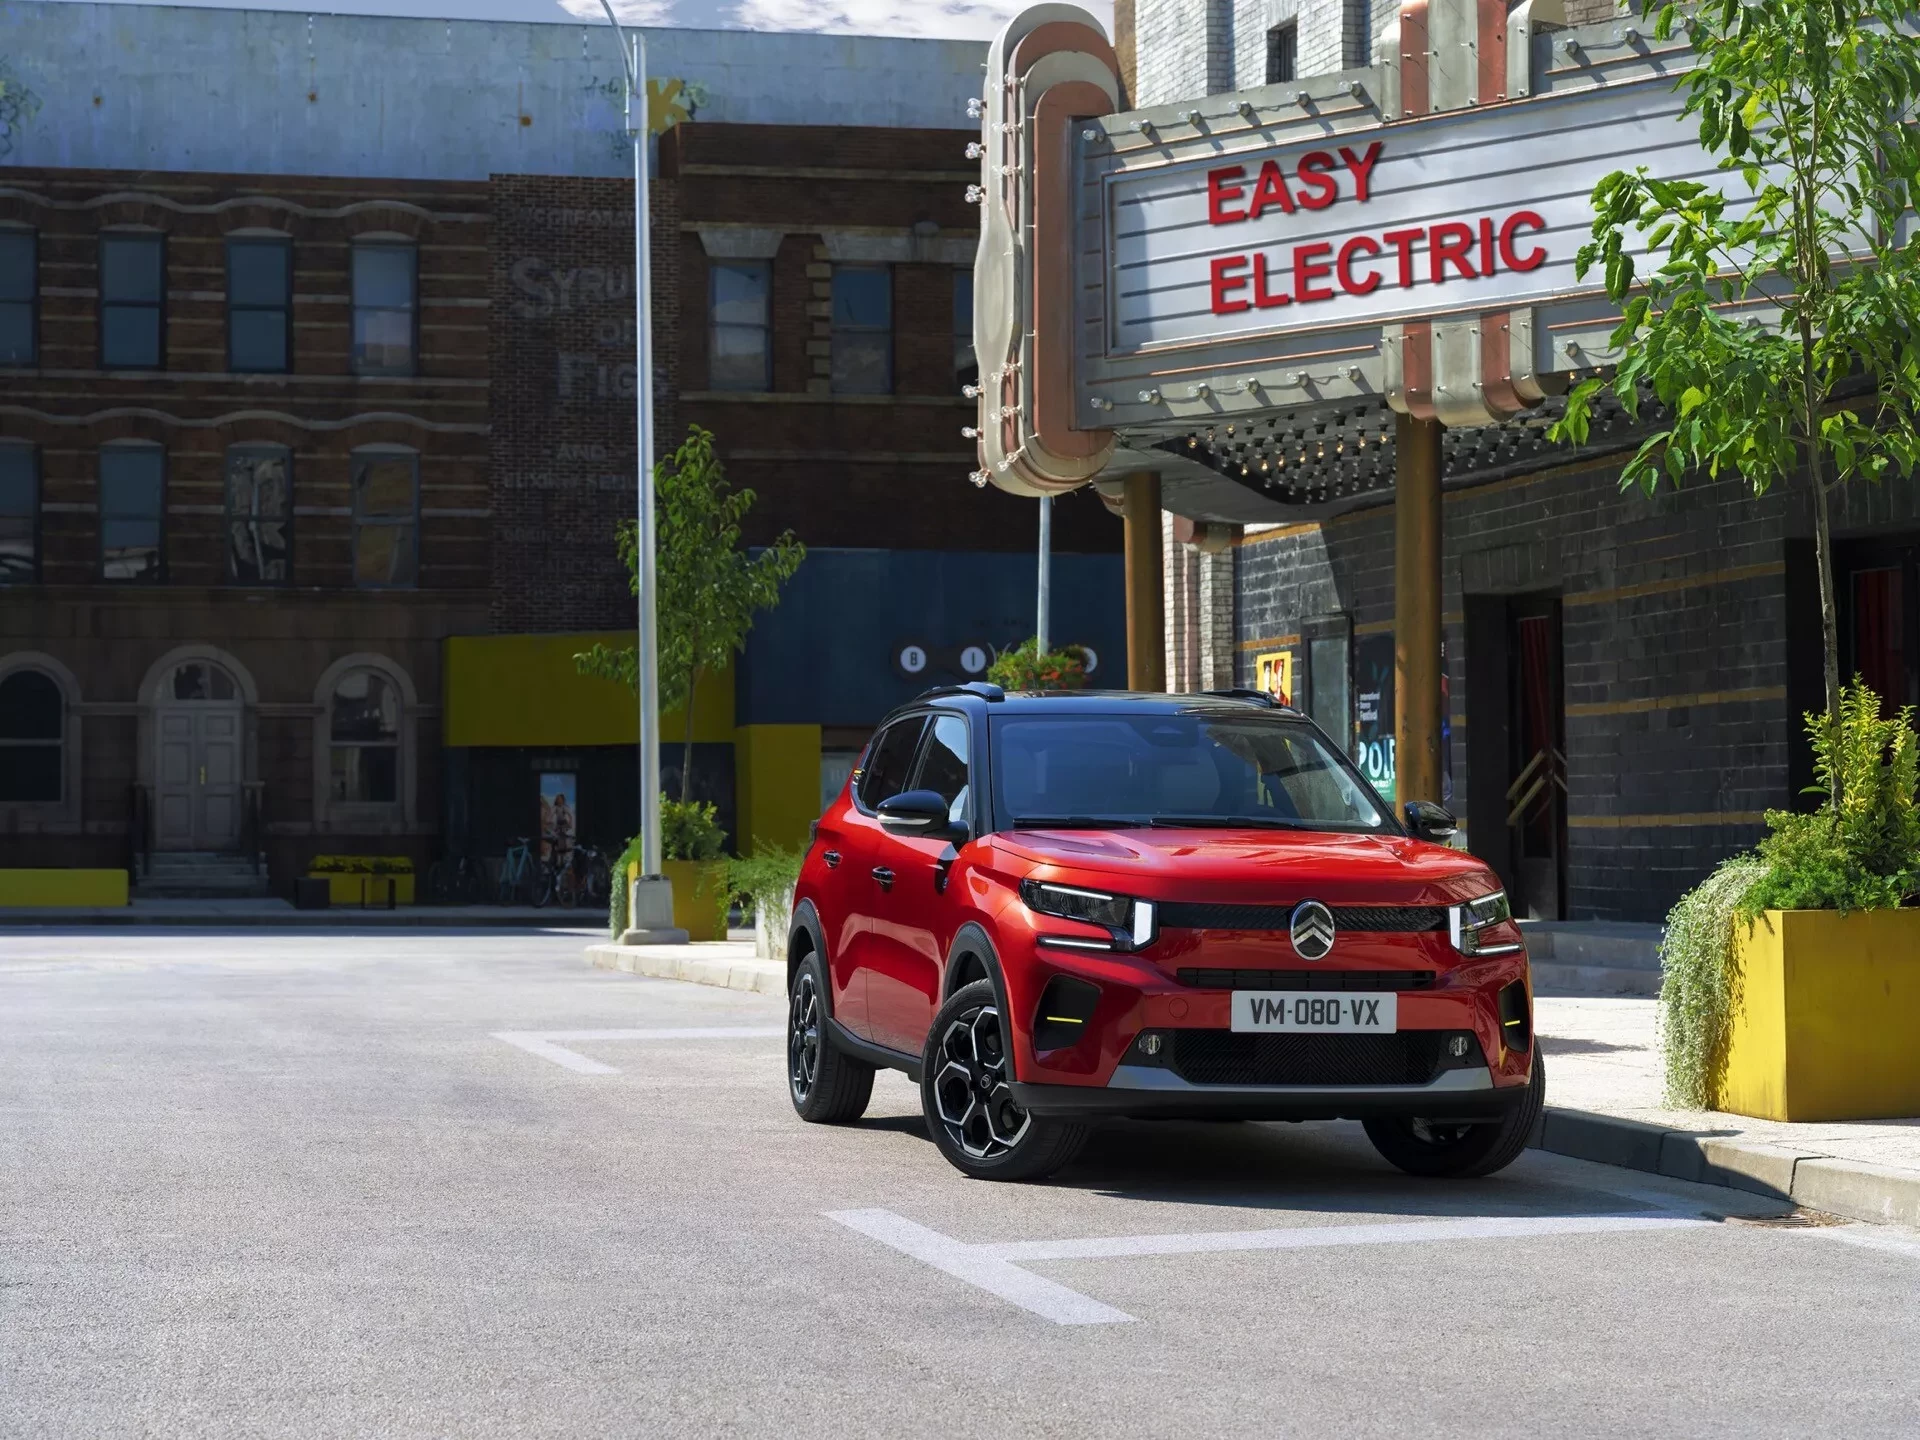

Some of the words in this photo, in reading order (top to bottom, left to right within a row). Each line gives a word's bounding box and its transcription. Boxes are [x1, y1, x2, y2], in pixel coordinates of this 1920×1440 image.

[1207, 141, 1384, 226] EASY
[511, 256, 637, 319] SYRU
[1210, 211, 1547, 314] ELECTRIC
[1250, 998, 1380, 1026] VM-080-VX
